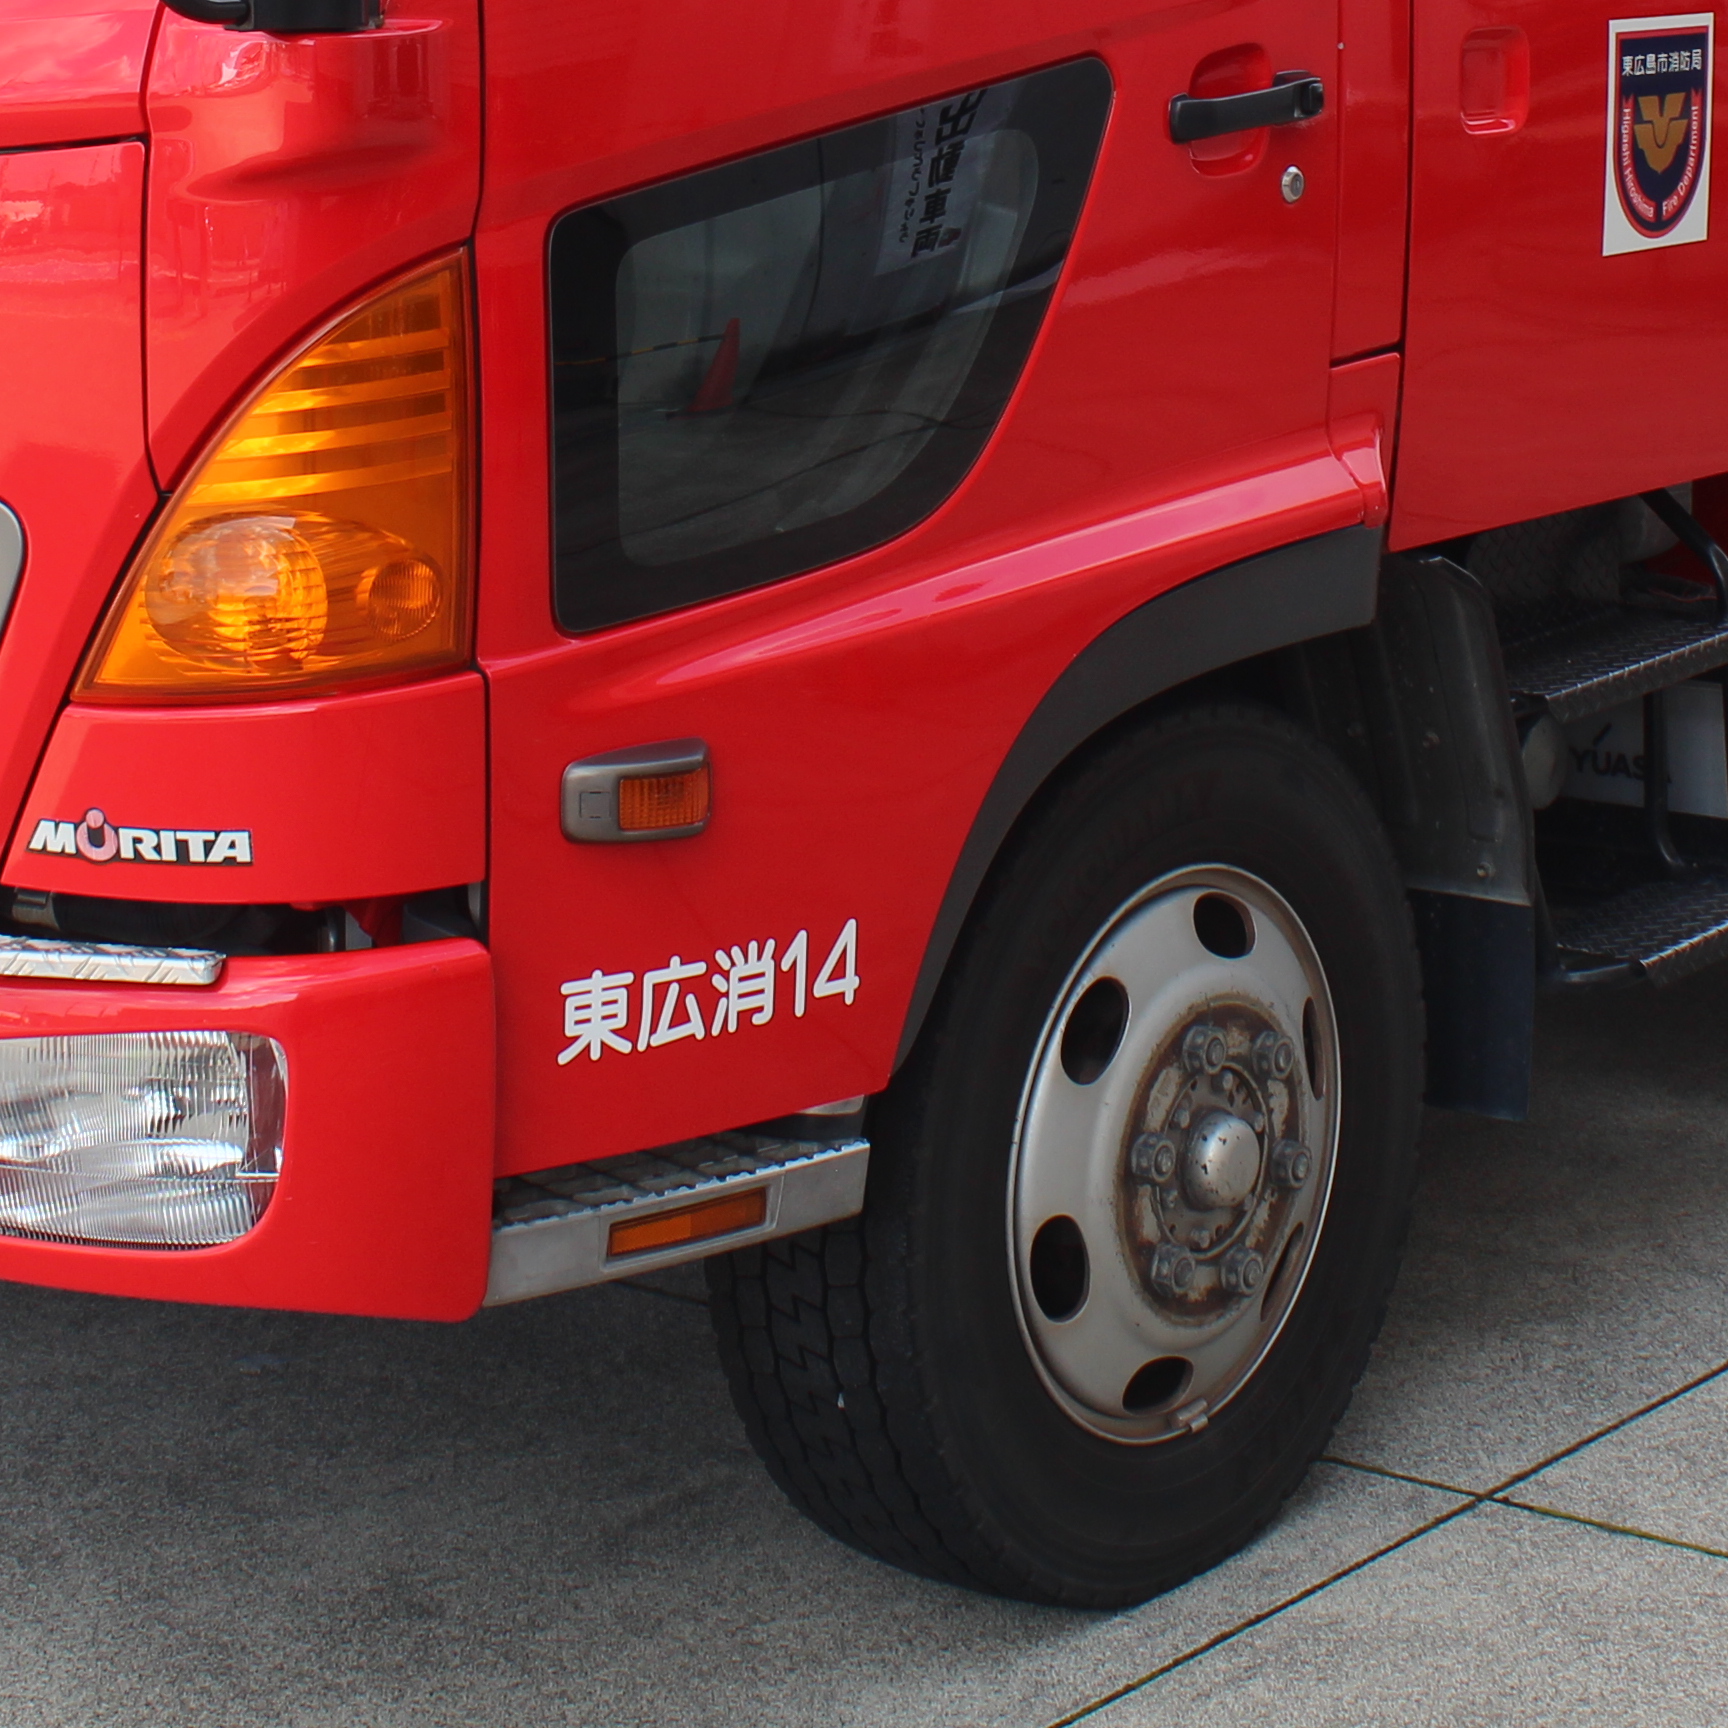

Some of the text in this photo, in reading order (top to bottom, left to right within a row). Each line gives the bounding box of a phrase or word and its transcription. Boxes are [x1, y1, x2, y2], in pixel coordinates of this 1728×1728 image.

[1622, 48, 1702, 77] 東広島市消防局
[1568, 745, 1672, 784] YUAS
[29, 808, 252, 866] MORITA
[556, 917, 860, 1067] 東広消14
